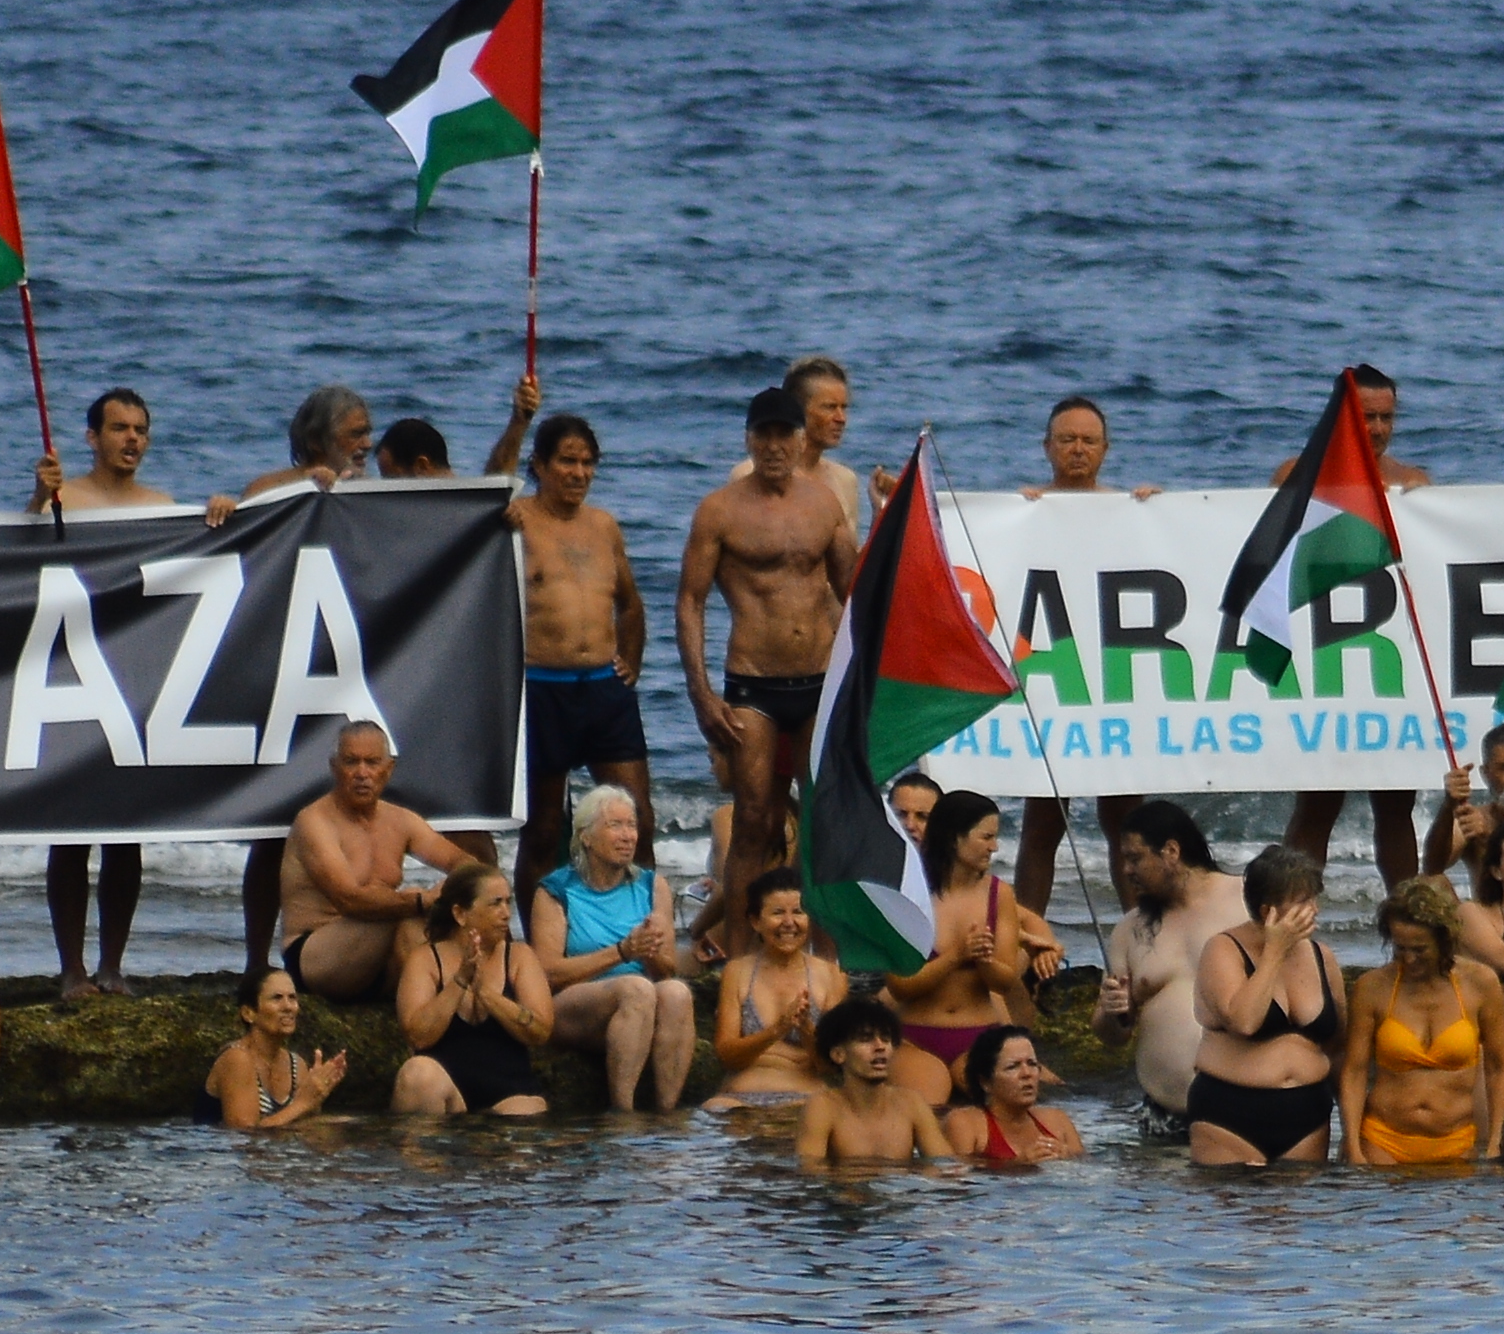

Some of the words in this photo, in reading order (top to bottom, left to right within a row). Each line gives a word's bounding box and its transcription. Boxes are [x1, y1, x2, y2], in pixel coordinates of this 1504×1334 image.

[930, 717, 1132, 759] ALVAR
[1156, 712, 1263, 755] LAS
[1289, 710, 1469, 752] VIDAS
